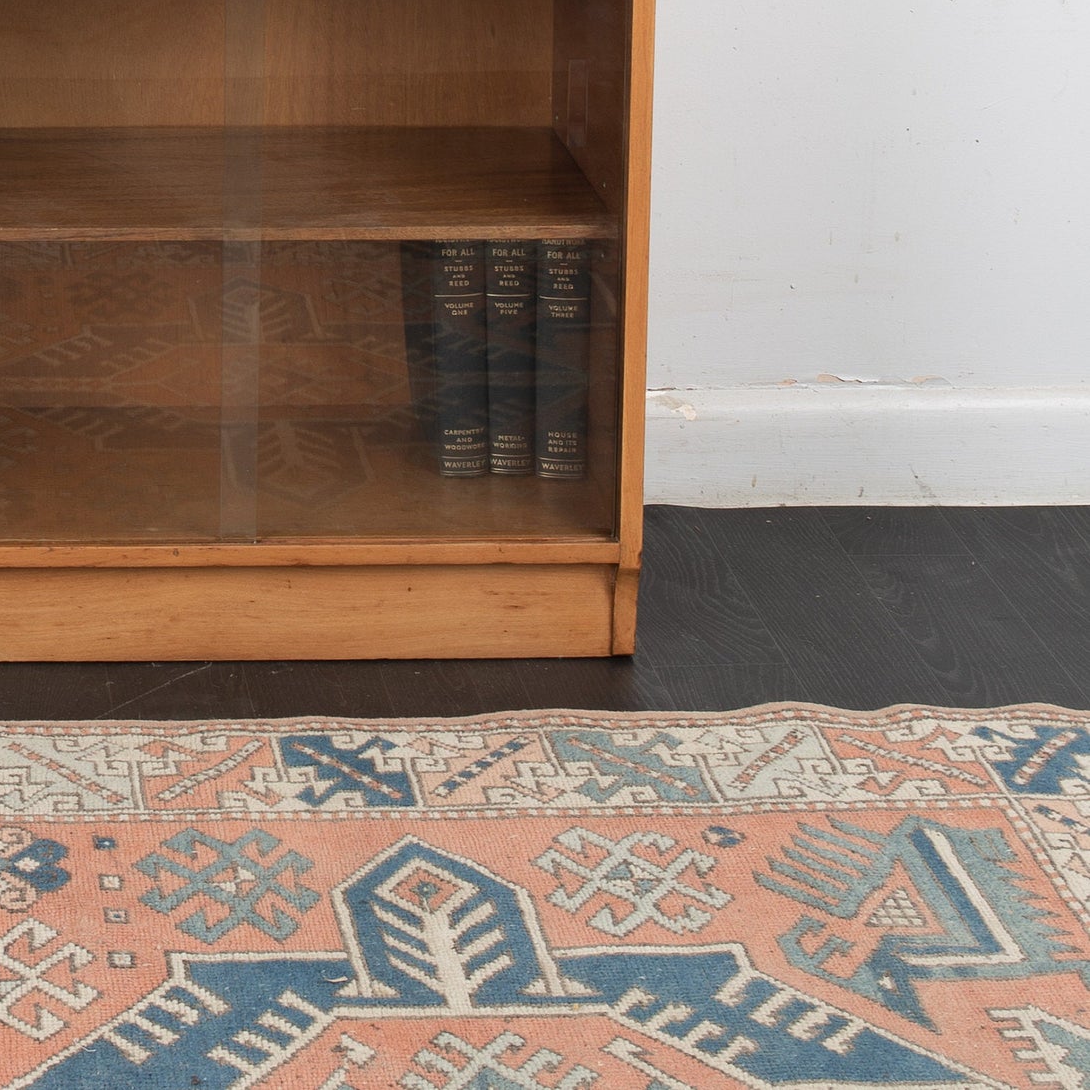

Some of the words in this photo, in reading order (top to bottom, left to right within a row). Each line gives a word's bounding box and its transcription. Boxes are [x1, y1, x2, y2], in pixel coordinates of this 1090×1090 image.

[460, 248, 475, 256] ALL
[547, 251, 563, 259] FOR
[444, 427, 485, 435] CARPENTRY
[444, 443, 486, 451] WOODWORK
[444, 460, 485, 468] WAVERLEY
[492, 458, 529, 466] WAVERLEY
[541, 462, 583, 471] WAVERLEY
